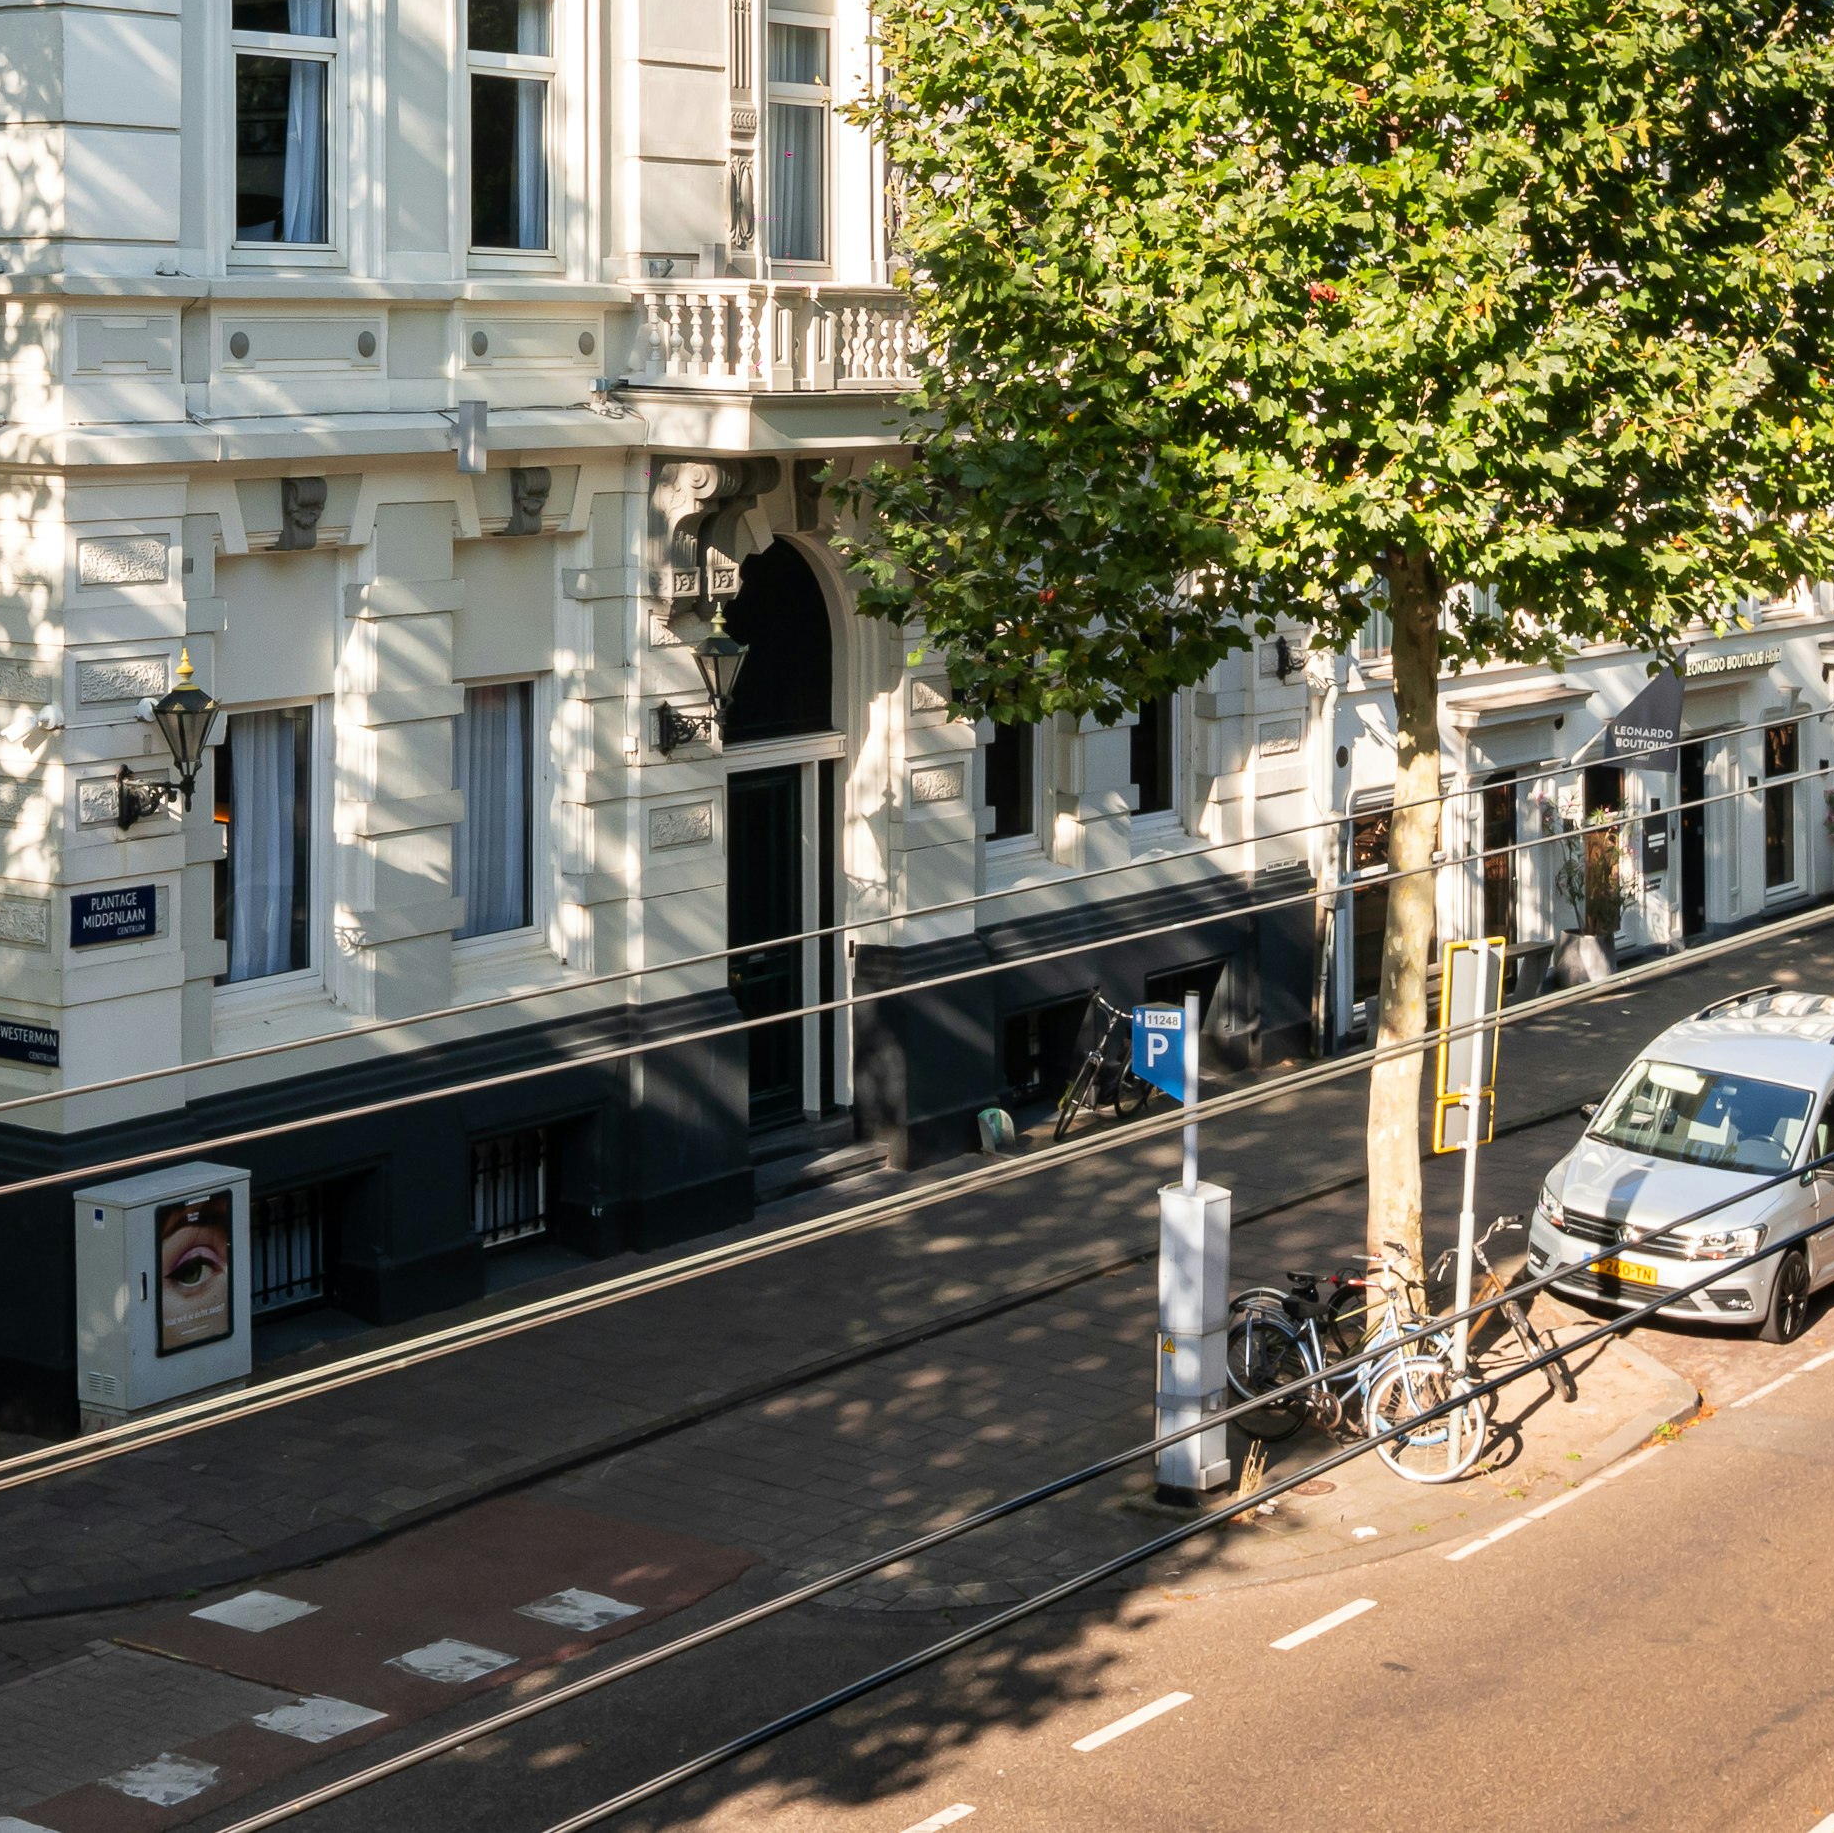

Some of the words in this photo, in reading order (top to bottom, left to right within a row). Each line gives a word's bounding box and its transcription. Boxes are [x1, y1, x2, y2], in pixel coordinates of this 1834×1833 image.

[1727, 651, 1764, 670] BOUTIQUE
[1614, 725, 1674, 740] LEONARDO
[91, 892, 137, 911] PLANTAGE
[82, 908, 146, 929] MIDDENLAAN
[117, 924, 146, 935] CENTRUM
[1148, 1015, 1178, 1026] 11248
[0, 1025, 57, 1047] WESTERMAN
[28, 1051, 57, 1063] CENTRUM
[1147, 1033, 1169, 1067] P
